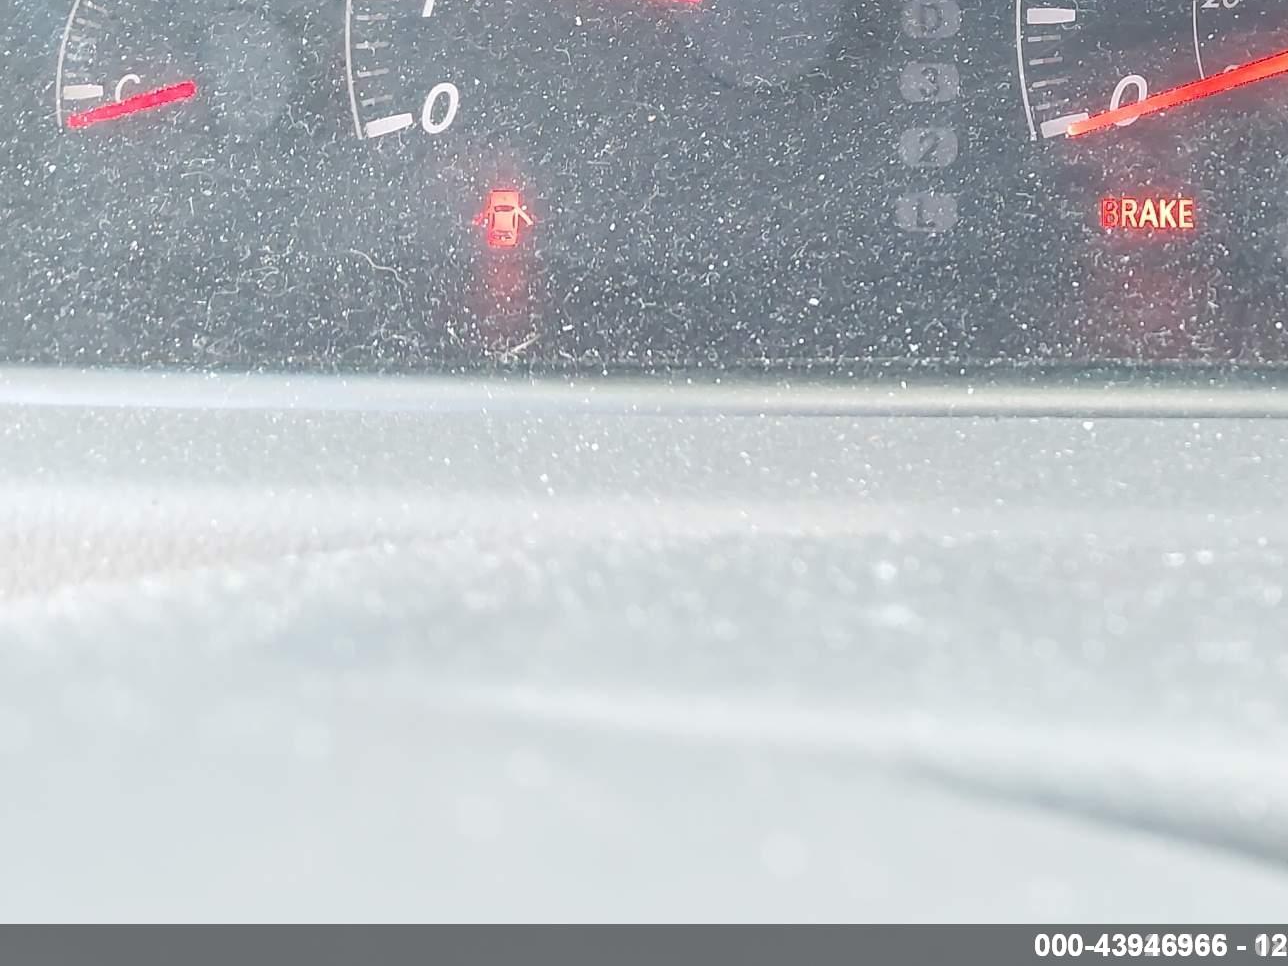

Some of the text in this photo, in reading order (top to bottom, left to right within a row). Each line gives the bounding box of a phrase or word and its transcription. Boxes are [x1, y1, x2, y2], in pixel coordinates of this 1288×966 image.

[421, 83, 459, 135] 0
[1110, 74, 1148, 127] 0
[1102, 198, 1194, 228] BRAKE
